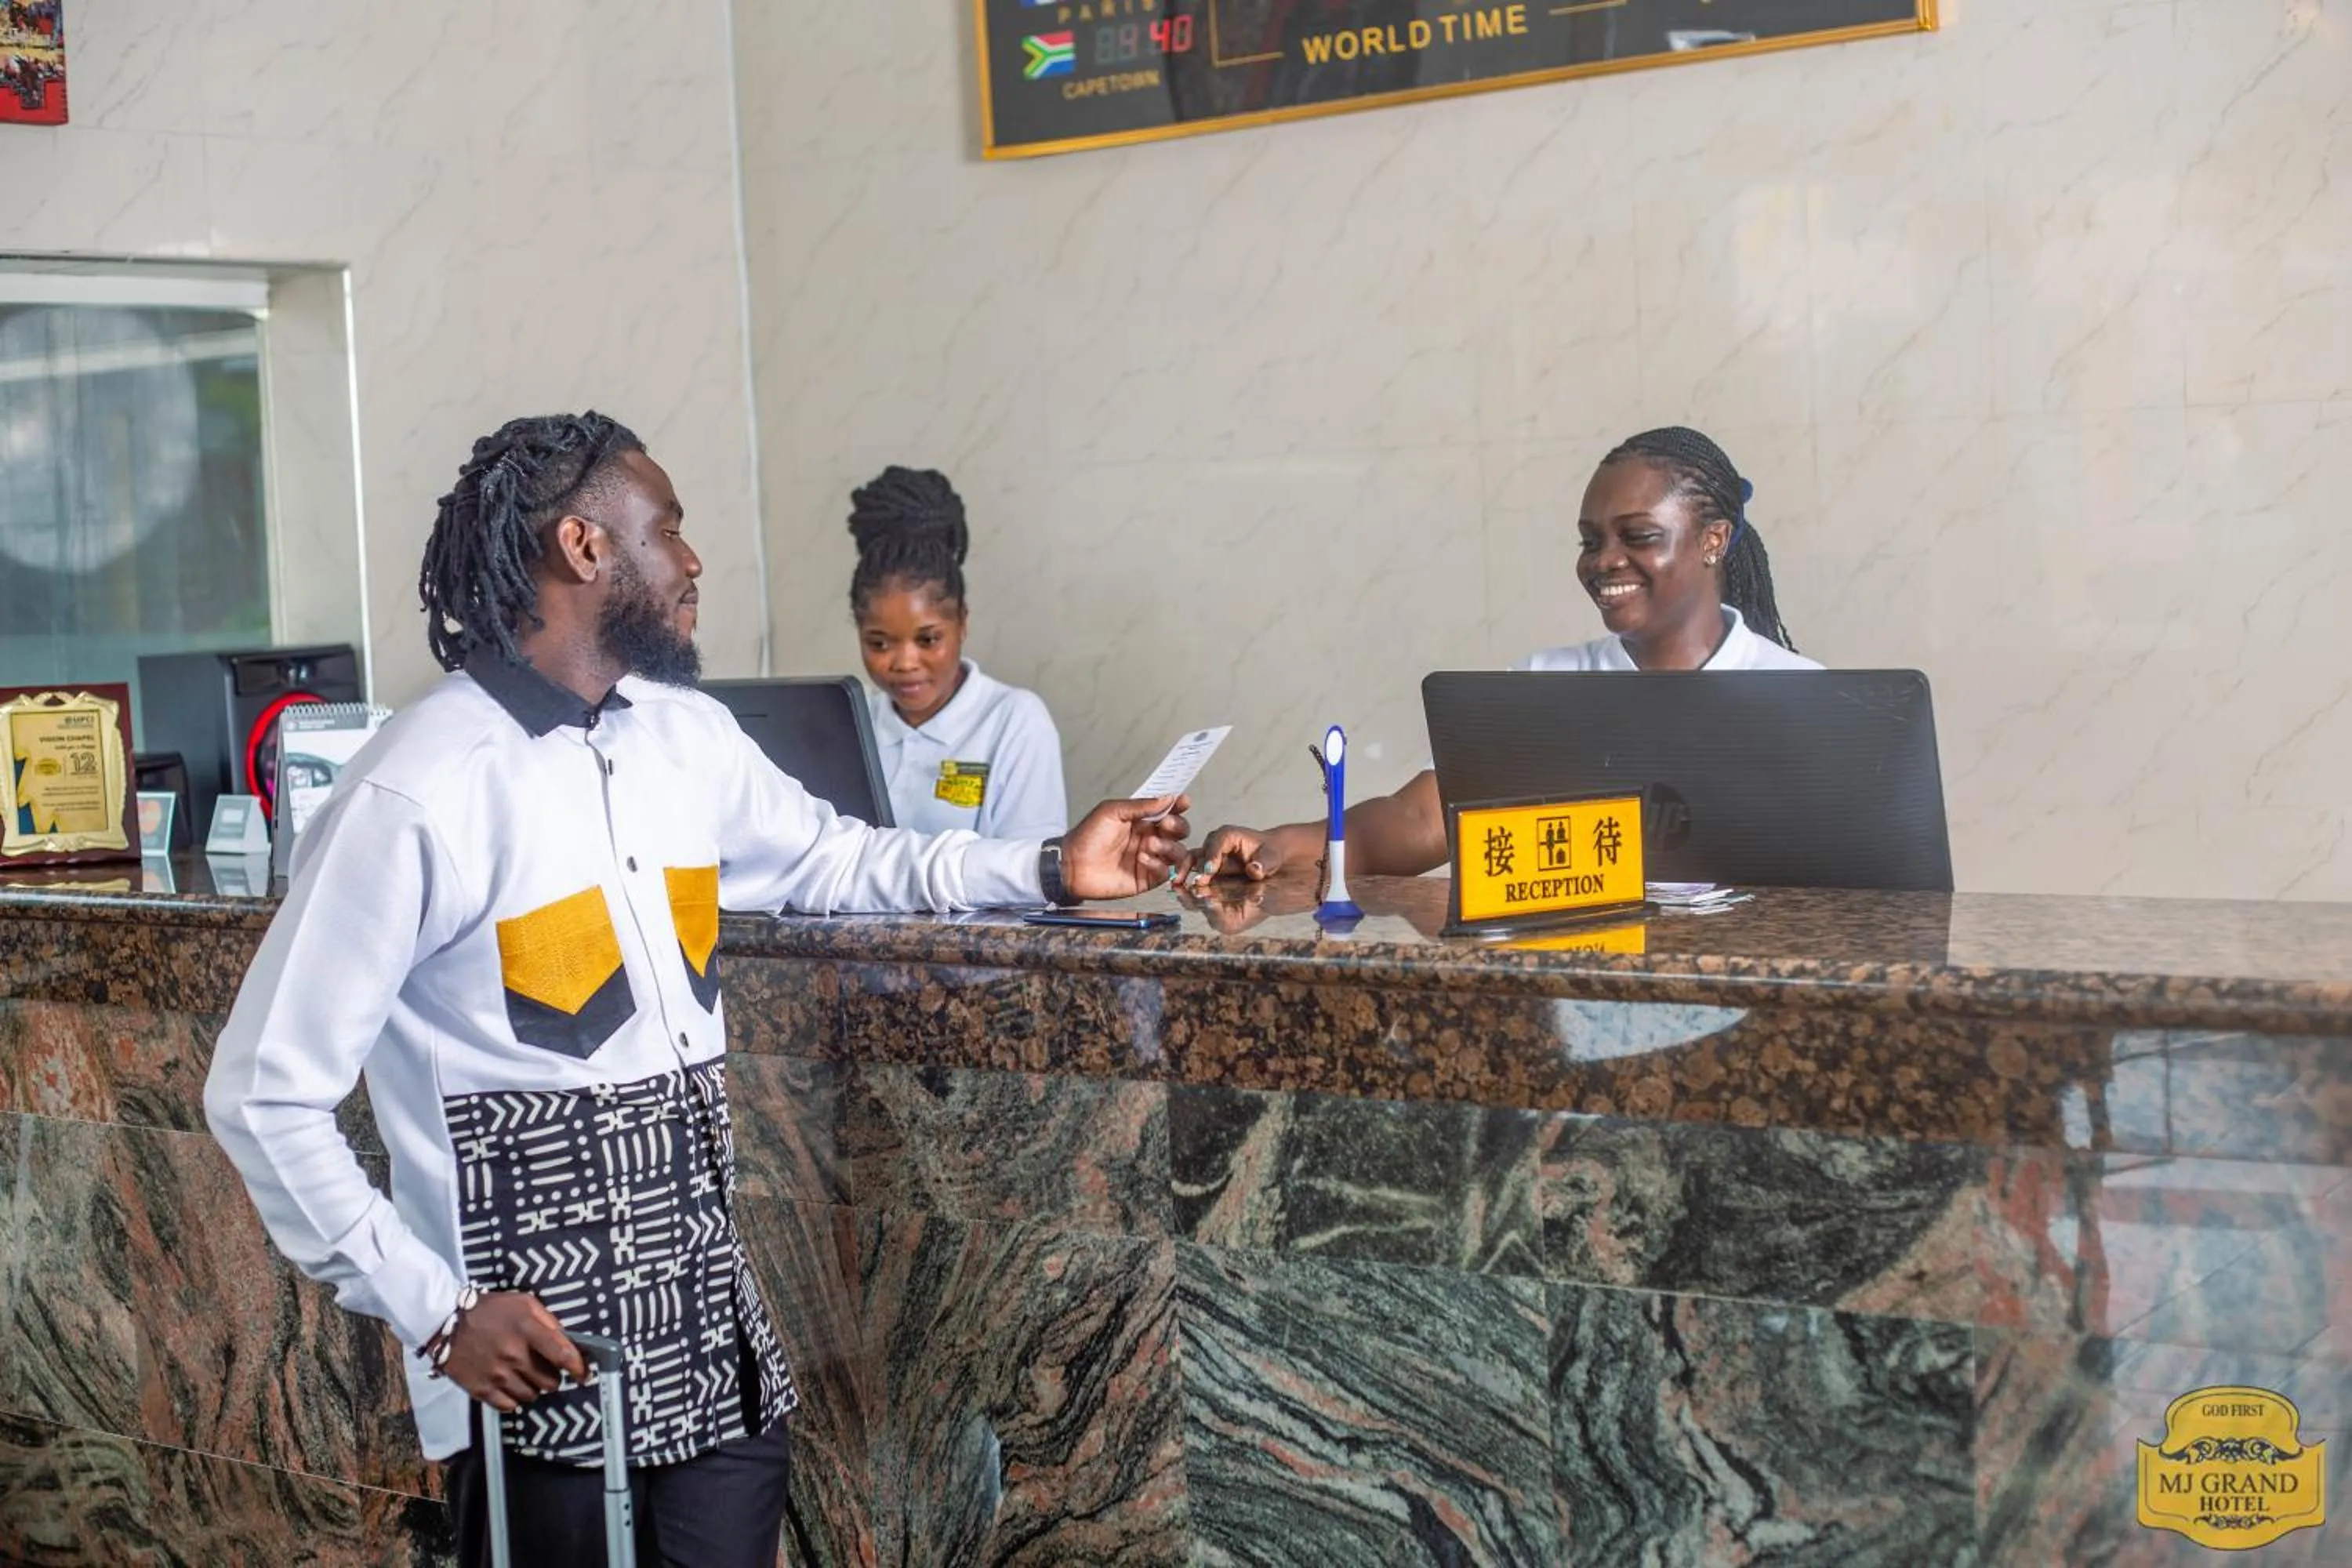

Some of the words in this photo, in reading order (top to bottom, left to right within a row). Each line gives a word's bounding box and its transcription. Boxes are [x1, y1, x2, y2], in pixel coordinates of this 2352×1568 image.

[1301, 19, 1432, 65] WORLD
[1437, 4, 1528, 43] TIME
[1483, 826, 1515, 877] 接
[1592, 816, 1621, 866] 待
[1505, 873, 1604, 902] RECEPTION
